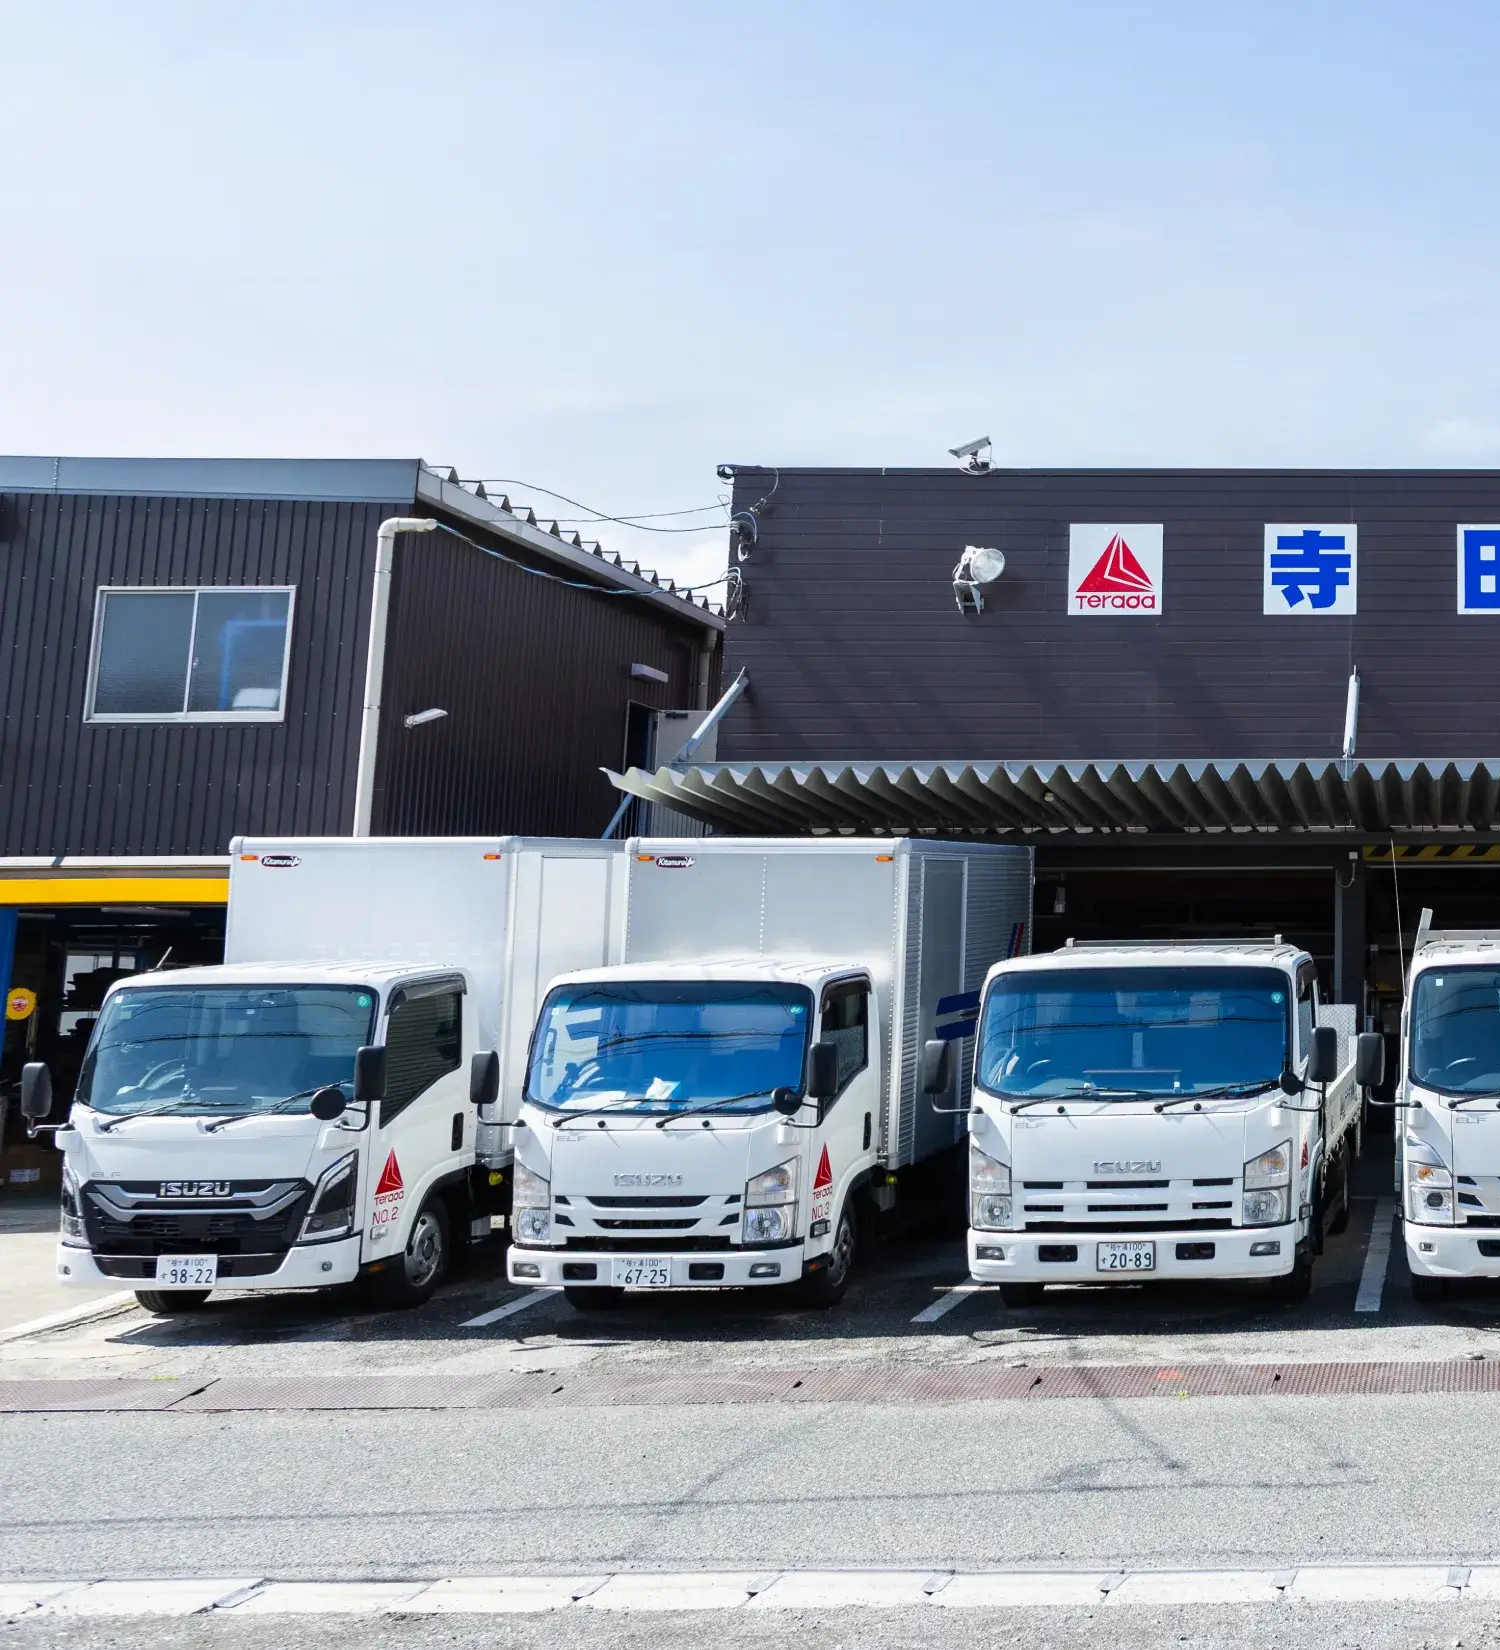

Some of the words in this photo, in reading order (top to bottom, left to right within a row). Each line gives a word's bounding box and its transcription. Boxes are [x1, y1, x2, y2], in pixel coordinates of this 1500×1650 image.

[1076, 595, 1155, 609] Terada
[1093, 1160, 1162, 1174] ISUZU
[613, 1173, 683, 1187] ISUZU
[160, 1182, 231, 1196] ISUZU
[374, 1190, 404, 1206] Terada
[1110, 1253, 1151, 1268] 20-89
[170, 1269, 213, 1283] 98-22
[625, 1269, 668, 1284] 67-25
